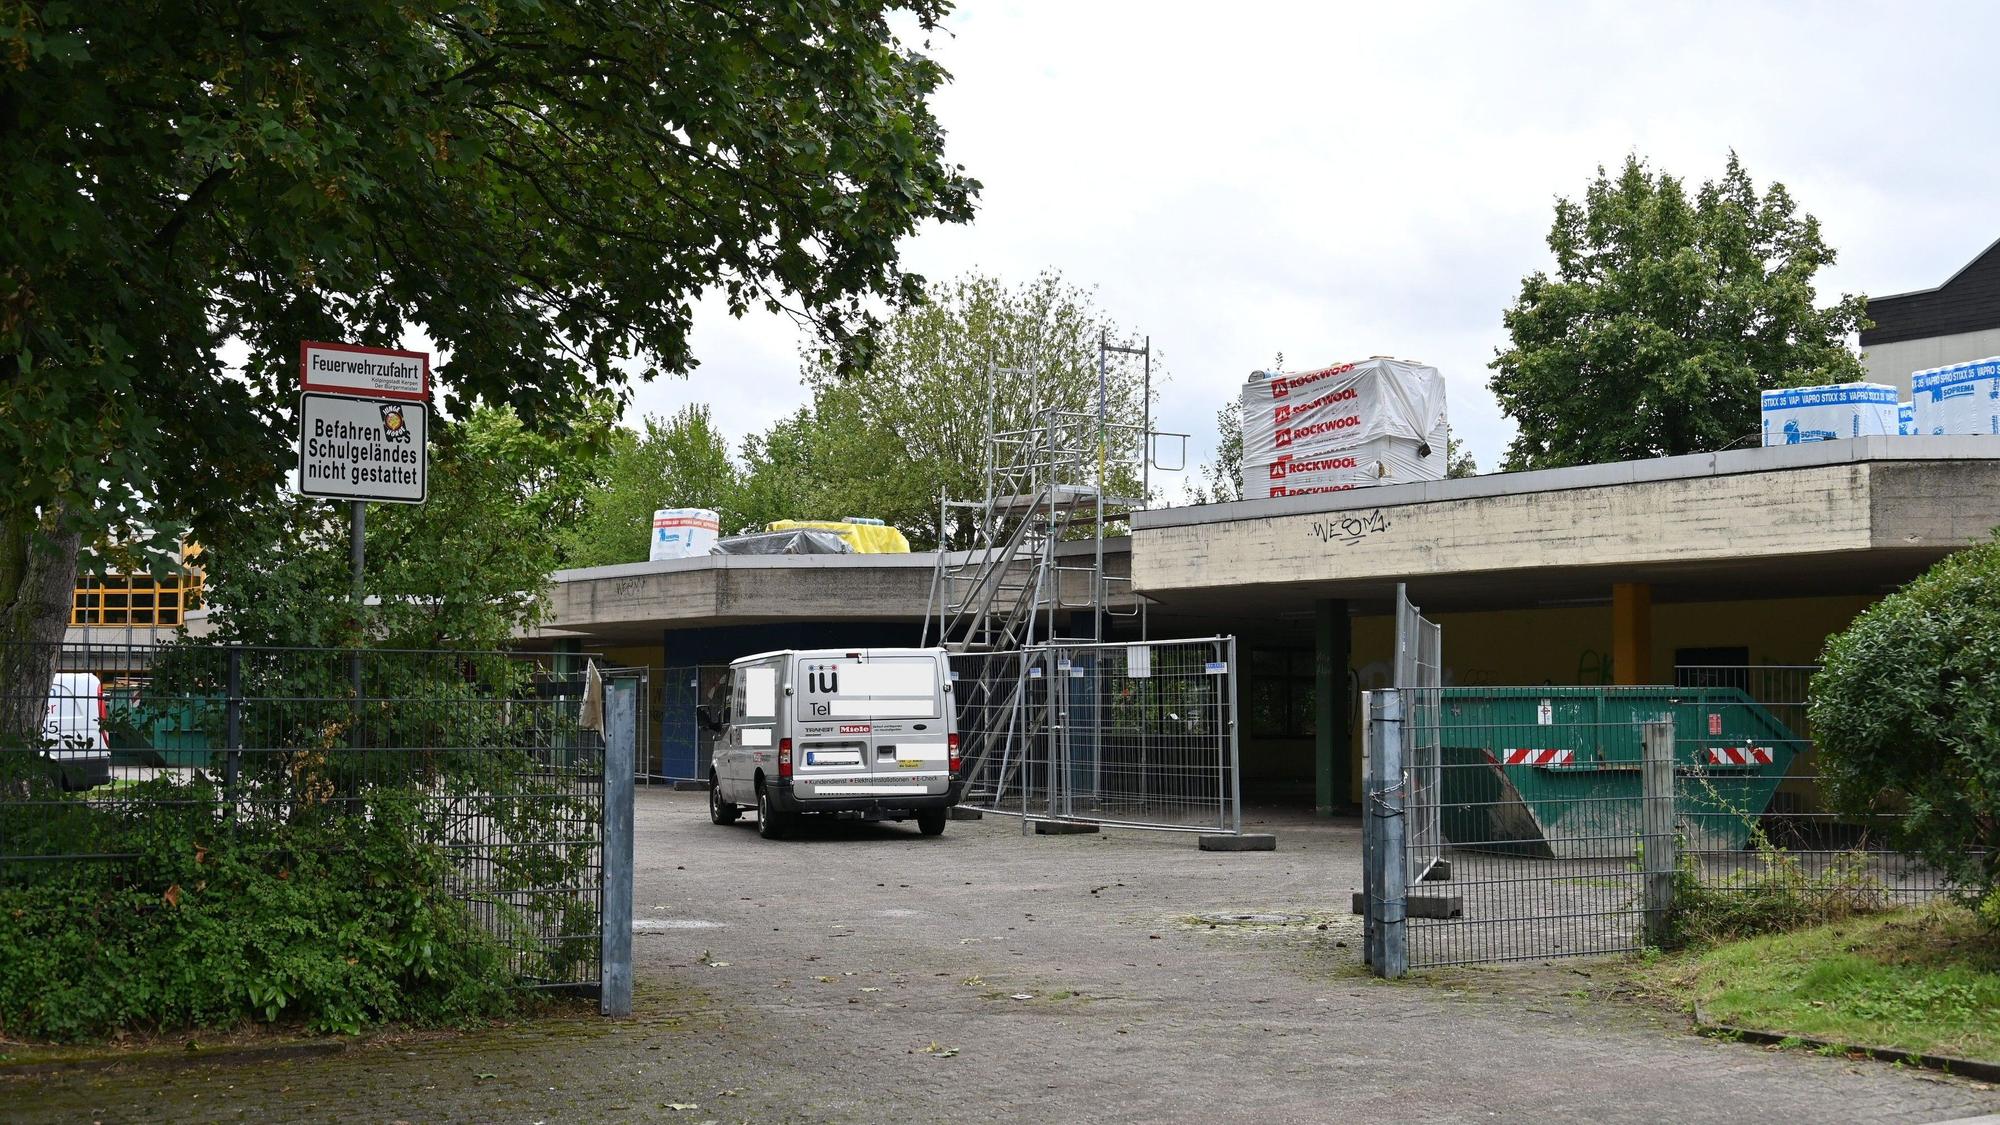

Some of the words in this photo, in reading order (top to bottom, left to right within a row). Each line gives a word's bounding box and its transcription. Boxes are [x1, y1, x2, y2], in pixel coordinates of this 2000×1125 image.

[312, 354, 418, 379] Feuerwehrzufahrt
[1289, 363, 1356, 388] ROCKWOOL
[1977, 365, 1995, 376] VAPRO
[1293, 388, 1358, 413] ROCKWOOL
[1779, 397, 1787, 406] 35
[1802, 394, 1820, 404] VAPRO
[1840, 392, 1847, 401] 35
[1849, 391, 1869, 401] VAPRO
[1943, 384, 1974, 397] SOPREMA
[315, 418, 381, 442] Befahren
[1294, 415, 1361, 439] ROCKWOOL
[1800, 429, 1837, 439] SOPREMA
[309, 438, 417, 464] Schulgeländes
[309, 460, 346, 480] nicht
[351, 465, 417, 485] gestattet
[1289, 458, 1357, 473] ROCKWOOL
